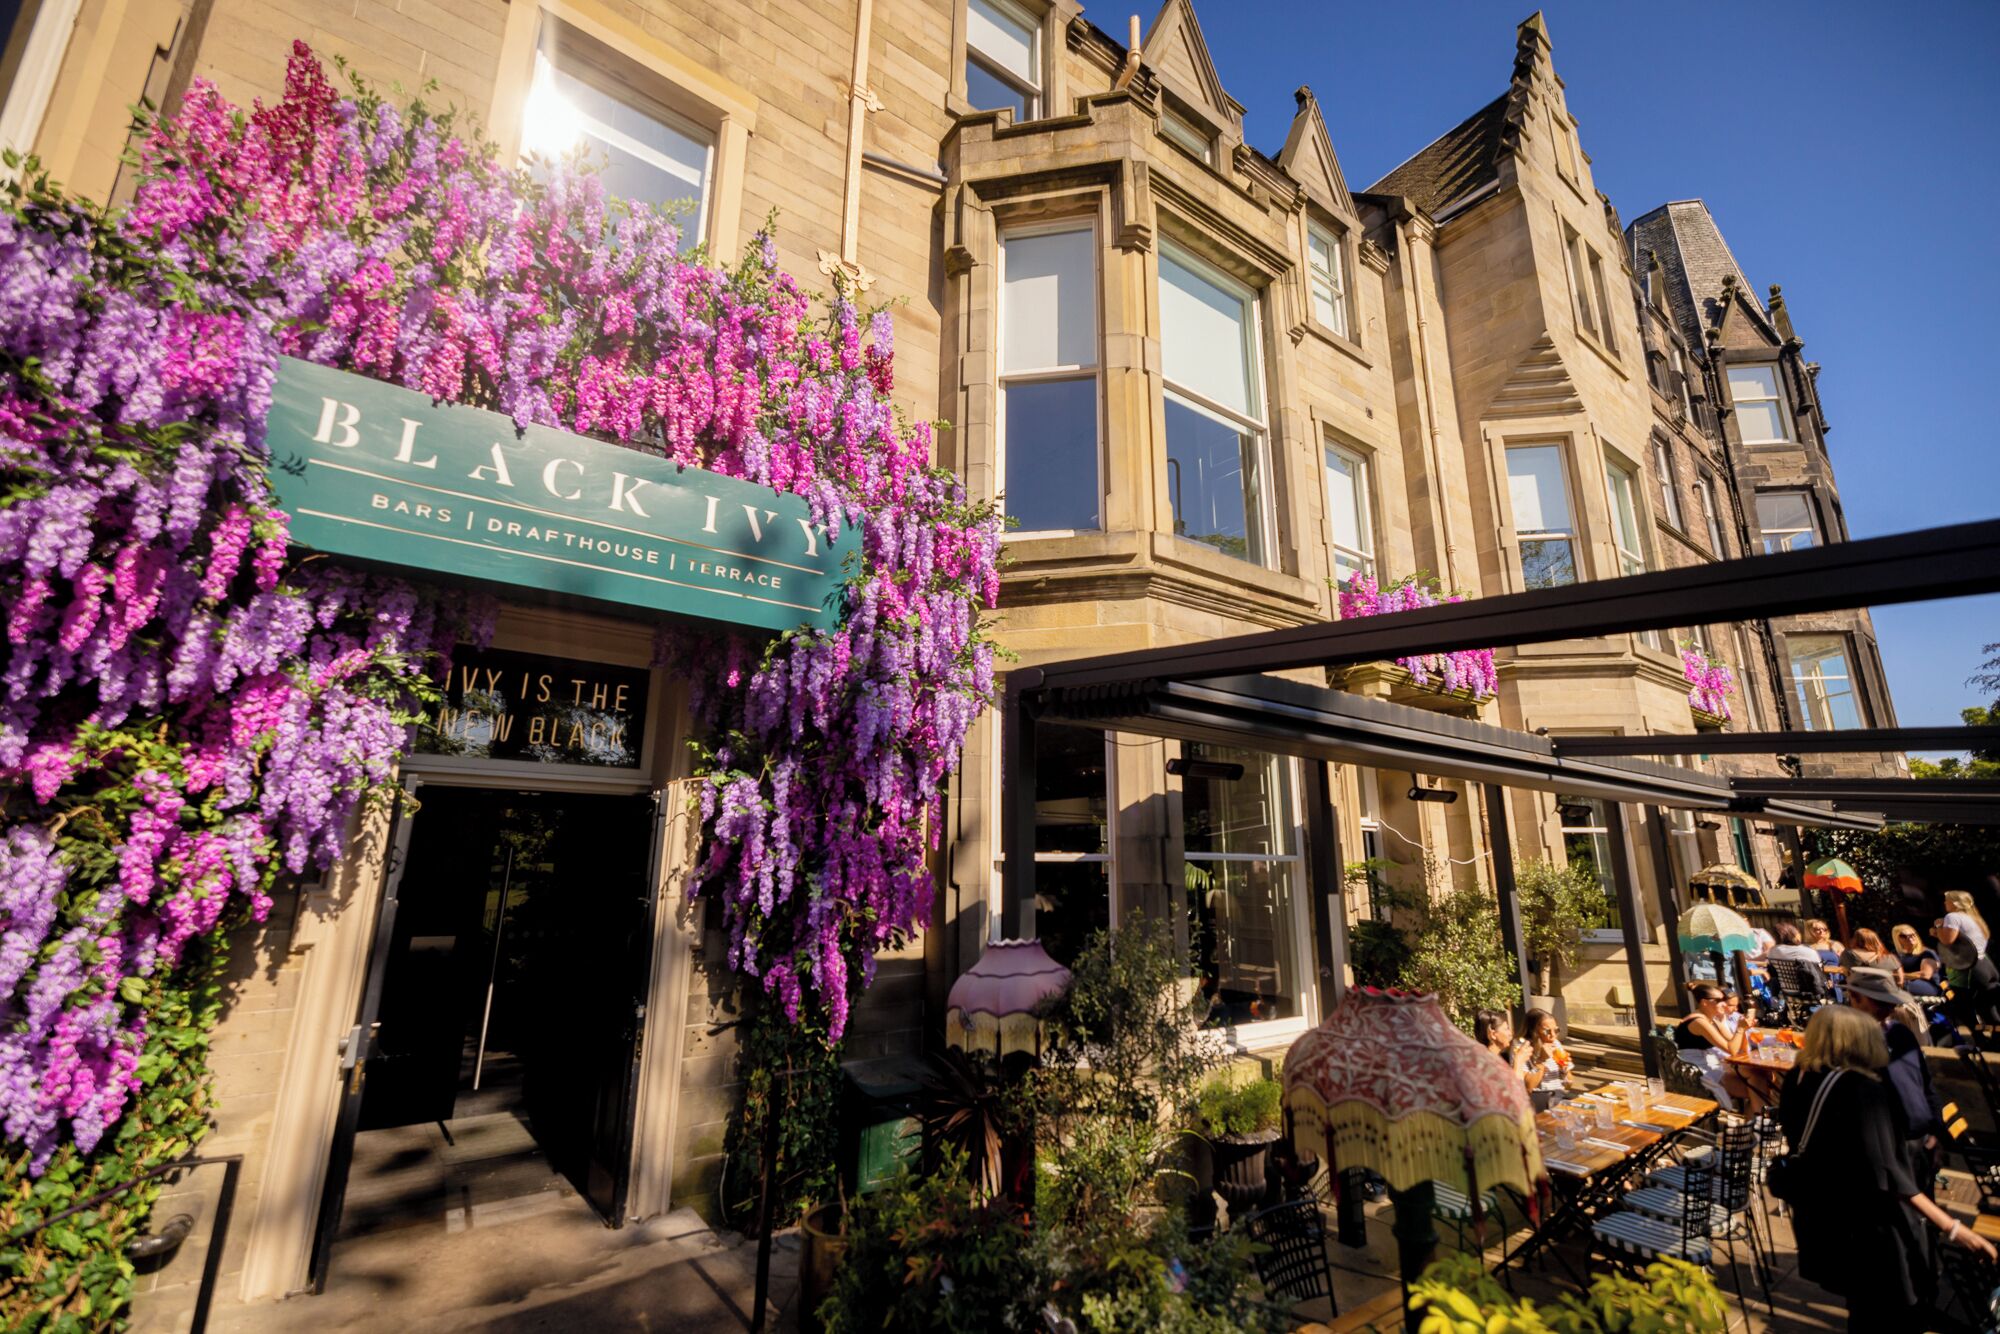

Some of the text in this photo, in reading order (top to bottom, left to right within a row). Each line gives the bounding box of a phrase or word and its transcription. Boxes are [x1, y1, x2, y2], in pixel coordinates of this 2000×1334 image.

[314, 398, 827, 557] BLACK IVY
[372, 495, 453, 523] BARS
[488, 518, 659, 565] DRAFTHOUSE
[688, 559, 782, 589] TERRACE
[522, 673, 552, 702] IS
[573, 680, 629, 711] THE
[437, 709, 625, 751] NEW BLACK
